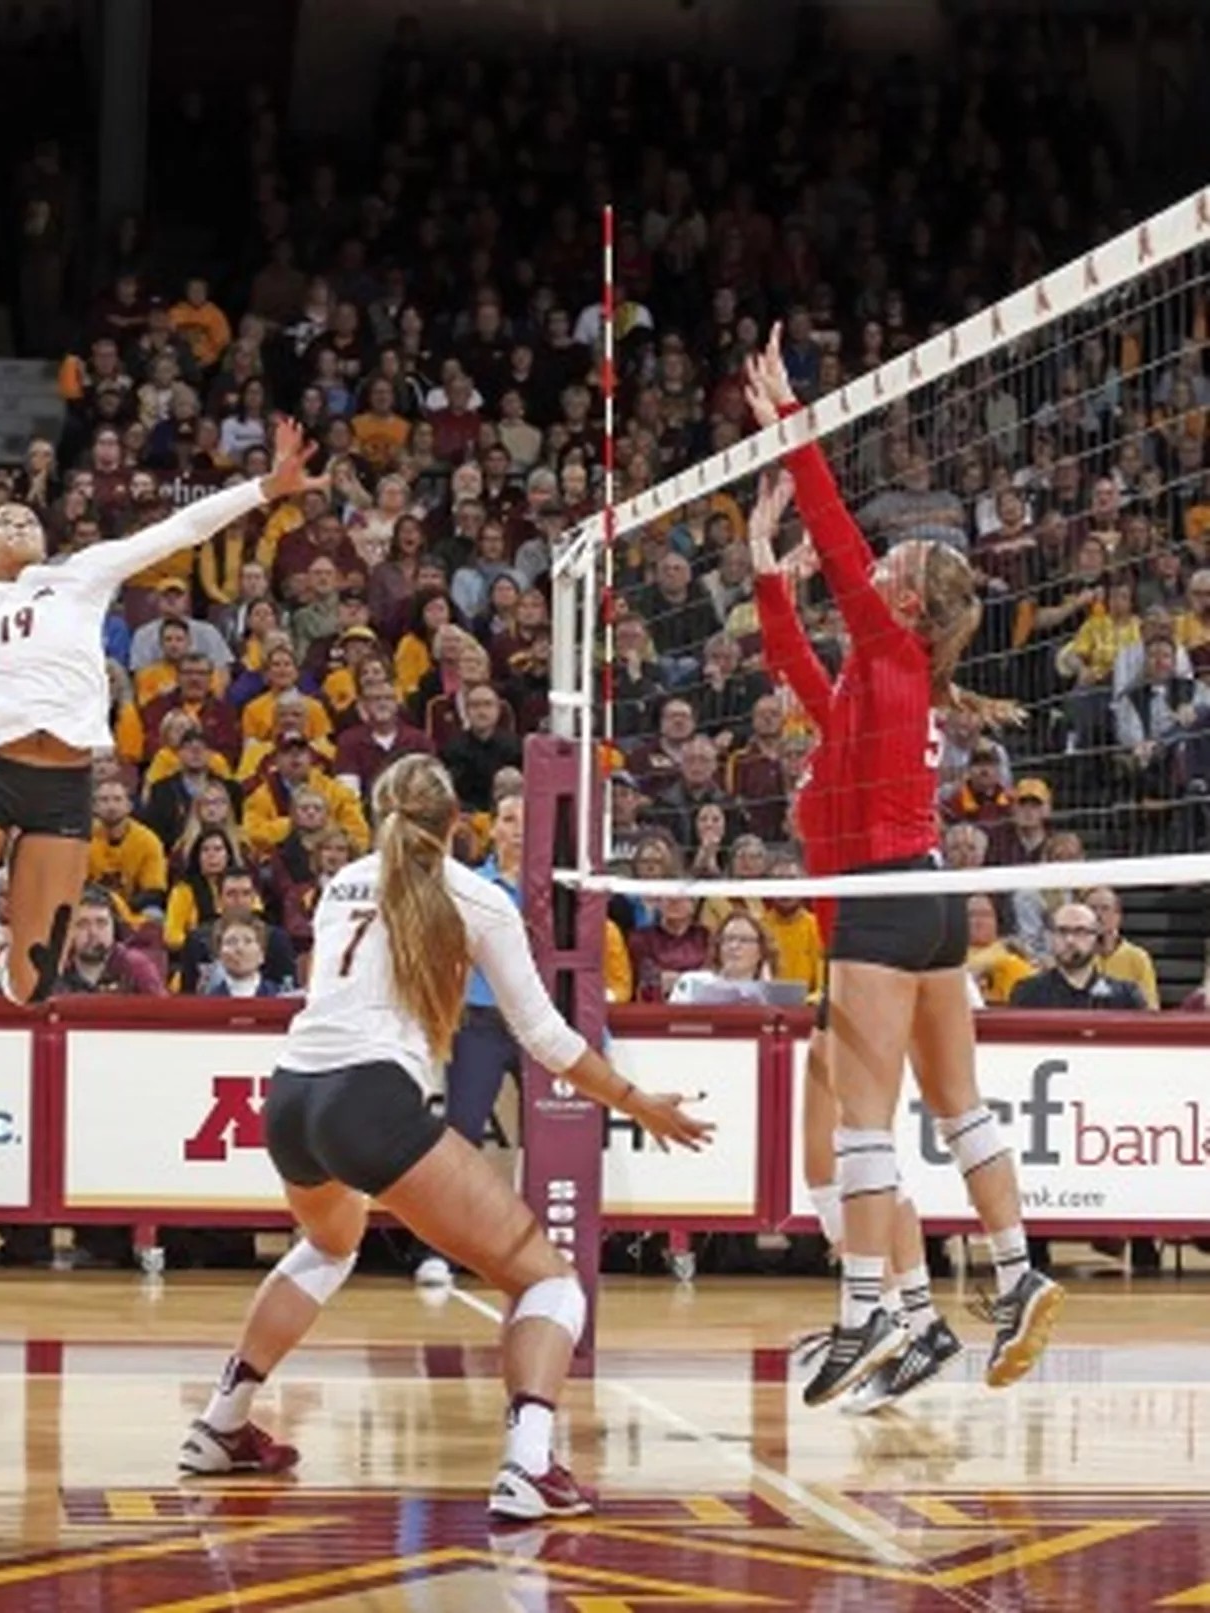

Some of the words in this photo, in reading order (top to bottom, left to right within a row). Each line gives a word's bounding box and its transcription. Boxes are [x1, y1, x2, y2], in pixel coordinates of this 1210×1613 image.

[0, 607, 34, 643] 19
[339, 909, 377, 977] 7
[909, 1059, 1069, 1165] tf
